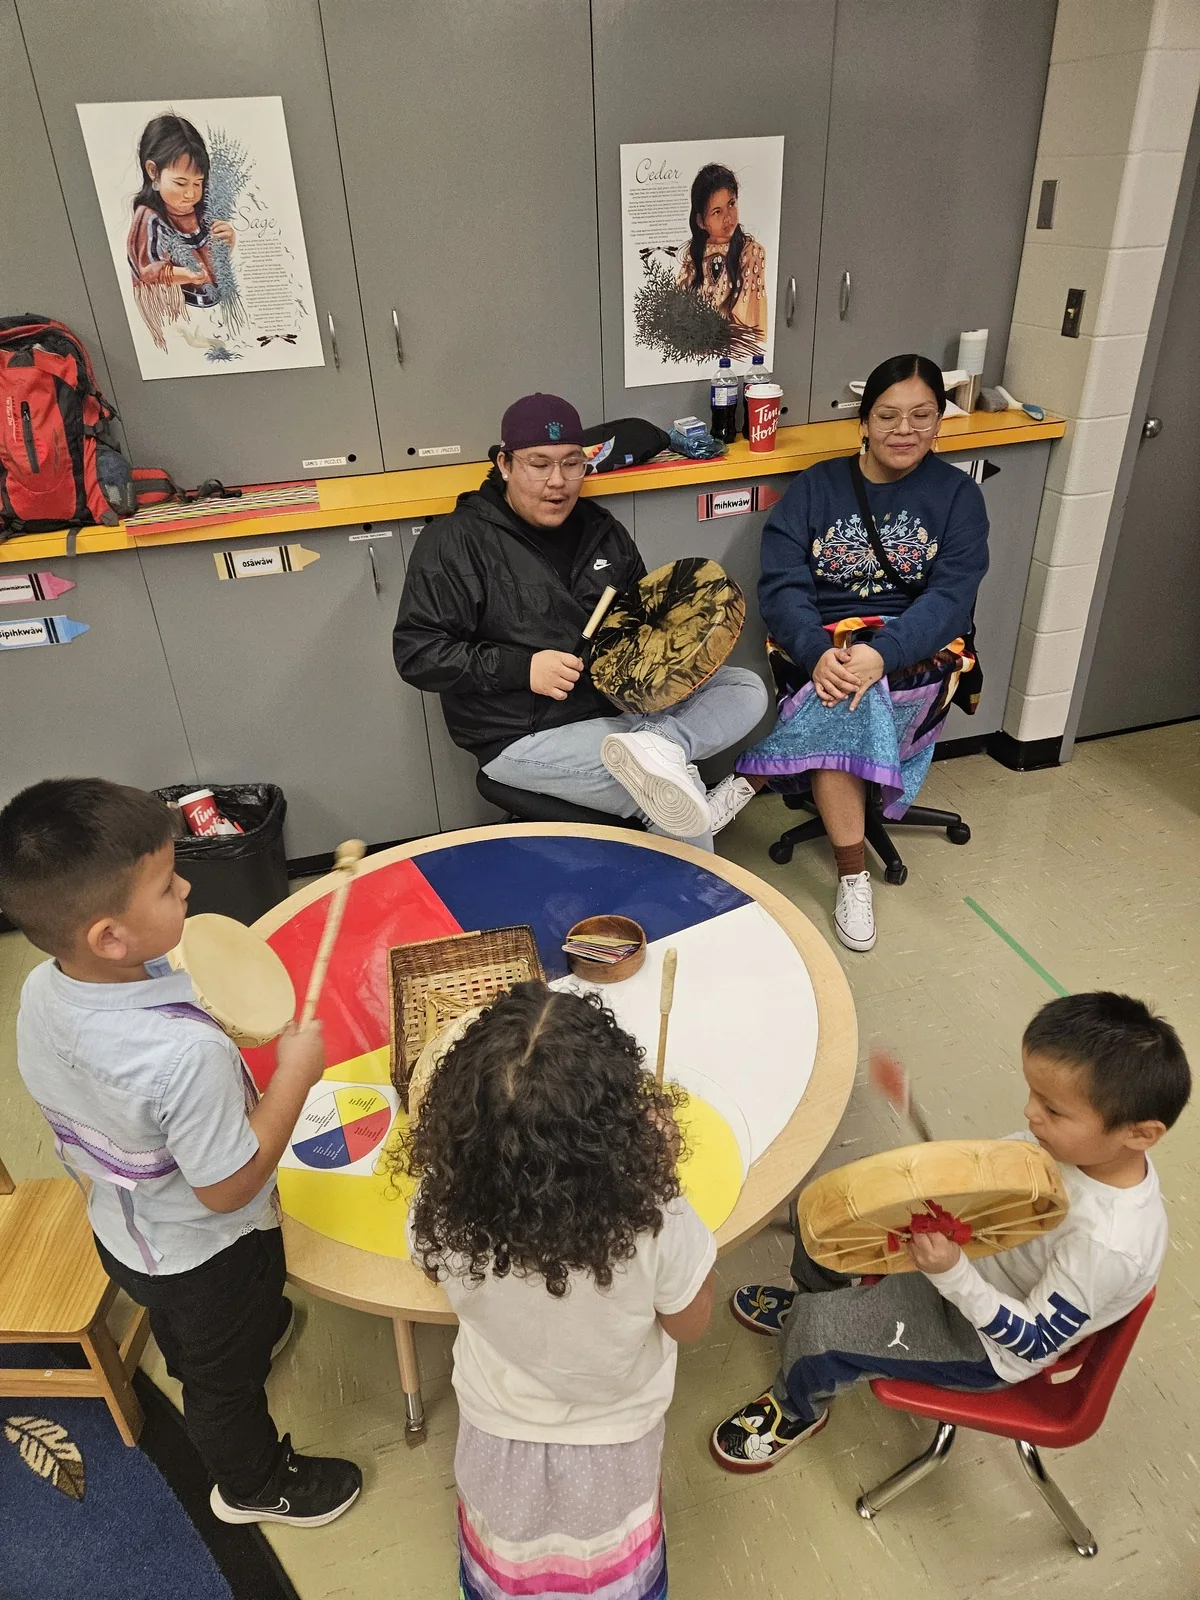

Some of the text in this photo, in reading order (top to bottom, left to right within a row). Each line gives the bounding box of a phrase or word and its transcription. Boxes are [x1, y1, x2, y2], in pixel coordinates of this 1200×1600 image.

[635, 157, 682, 184] Cedar
[232, 206, 277, 238] Sage
[754, 404, 780, 424] Tim
[189, 805, 215, 826] Tim
